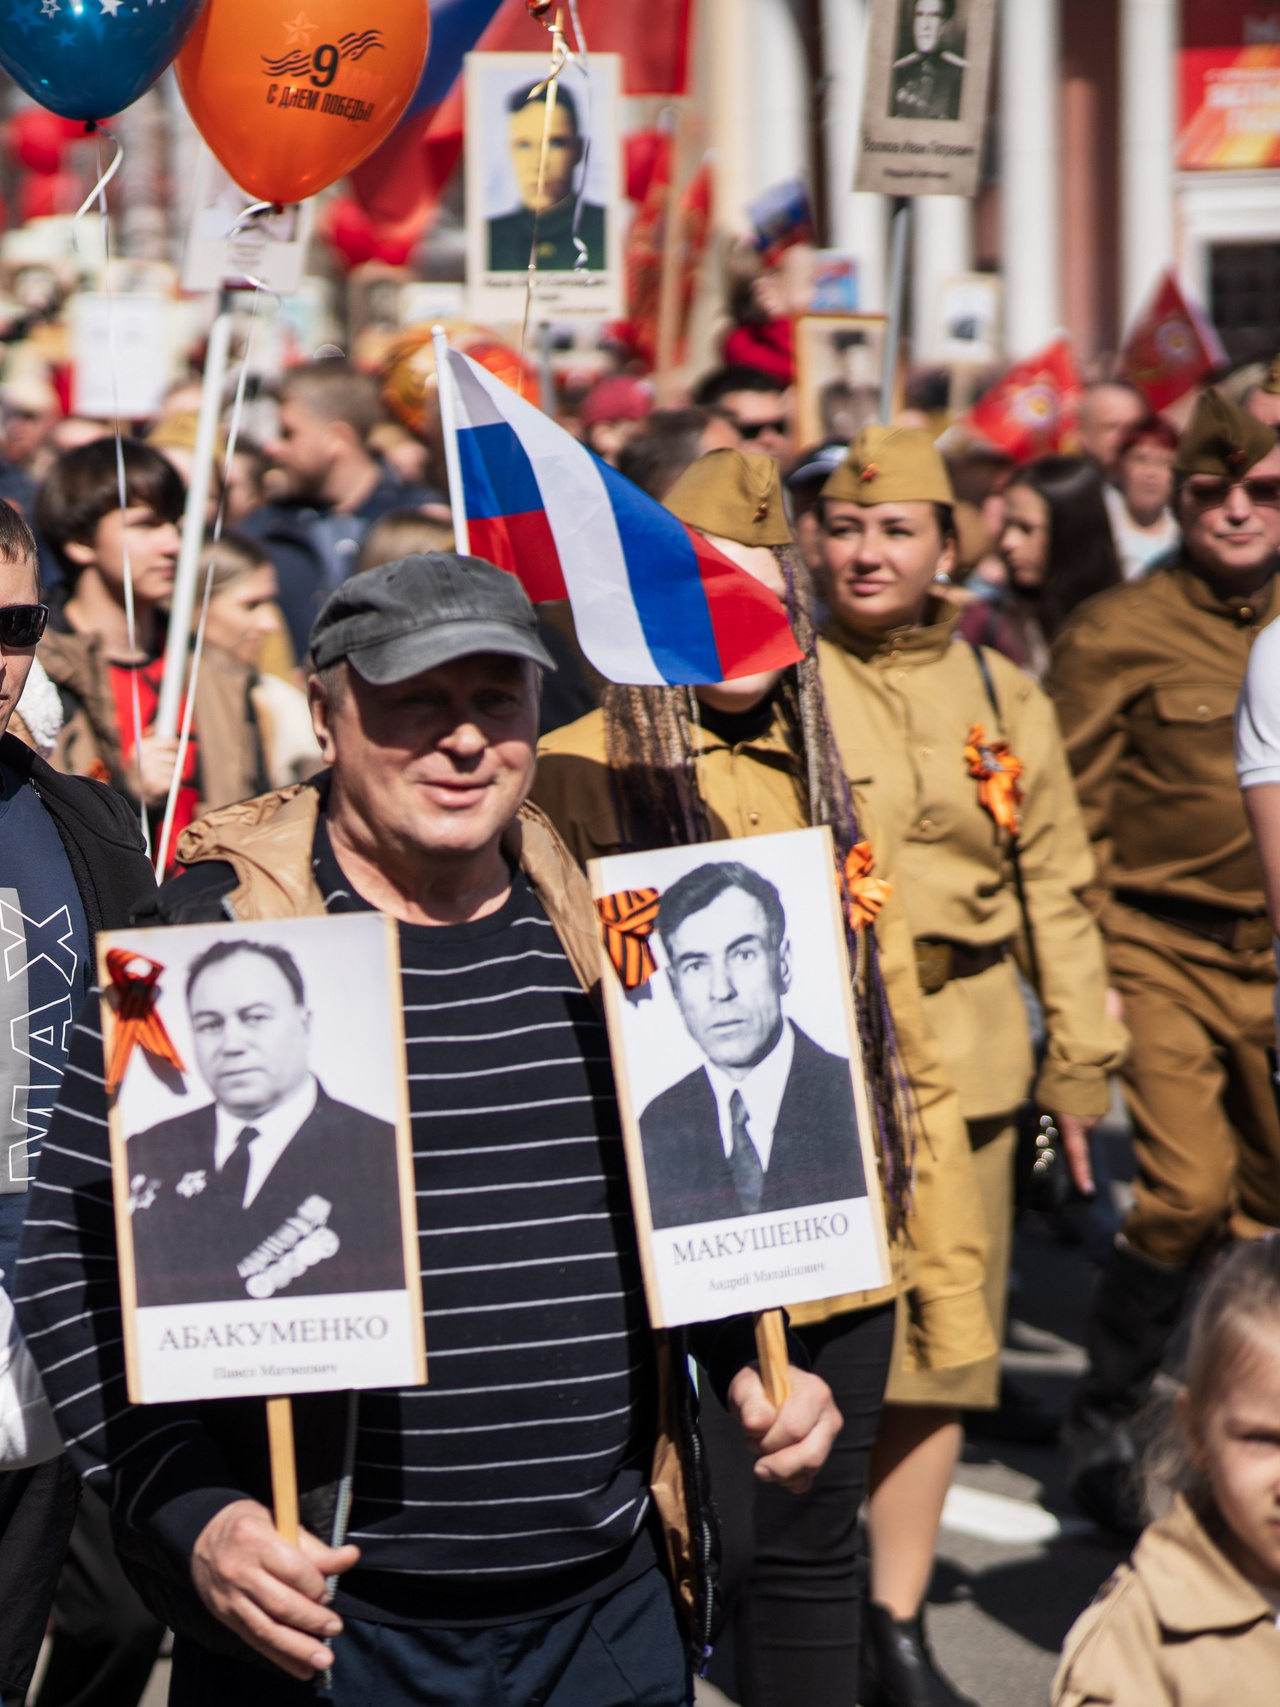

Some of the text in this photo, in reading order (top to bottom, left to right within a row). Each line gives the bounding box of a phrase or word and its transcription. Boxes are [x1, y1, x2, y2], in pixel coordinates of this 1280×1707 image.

[310, 44, 339, 88] 9
[266, 84, 278, 104] С
[278, 86, 320, 111] ДНЕМ
[672, 1211, 850, 1266] МАКУШЕНКО
[708, 1261, 827, 1293] Андрей Михайлович
[159, 1314, 389, 1351] АБАКУМЕНКО
